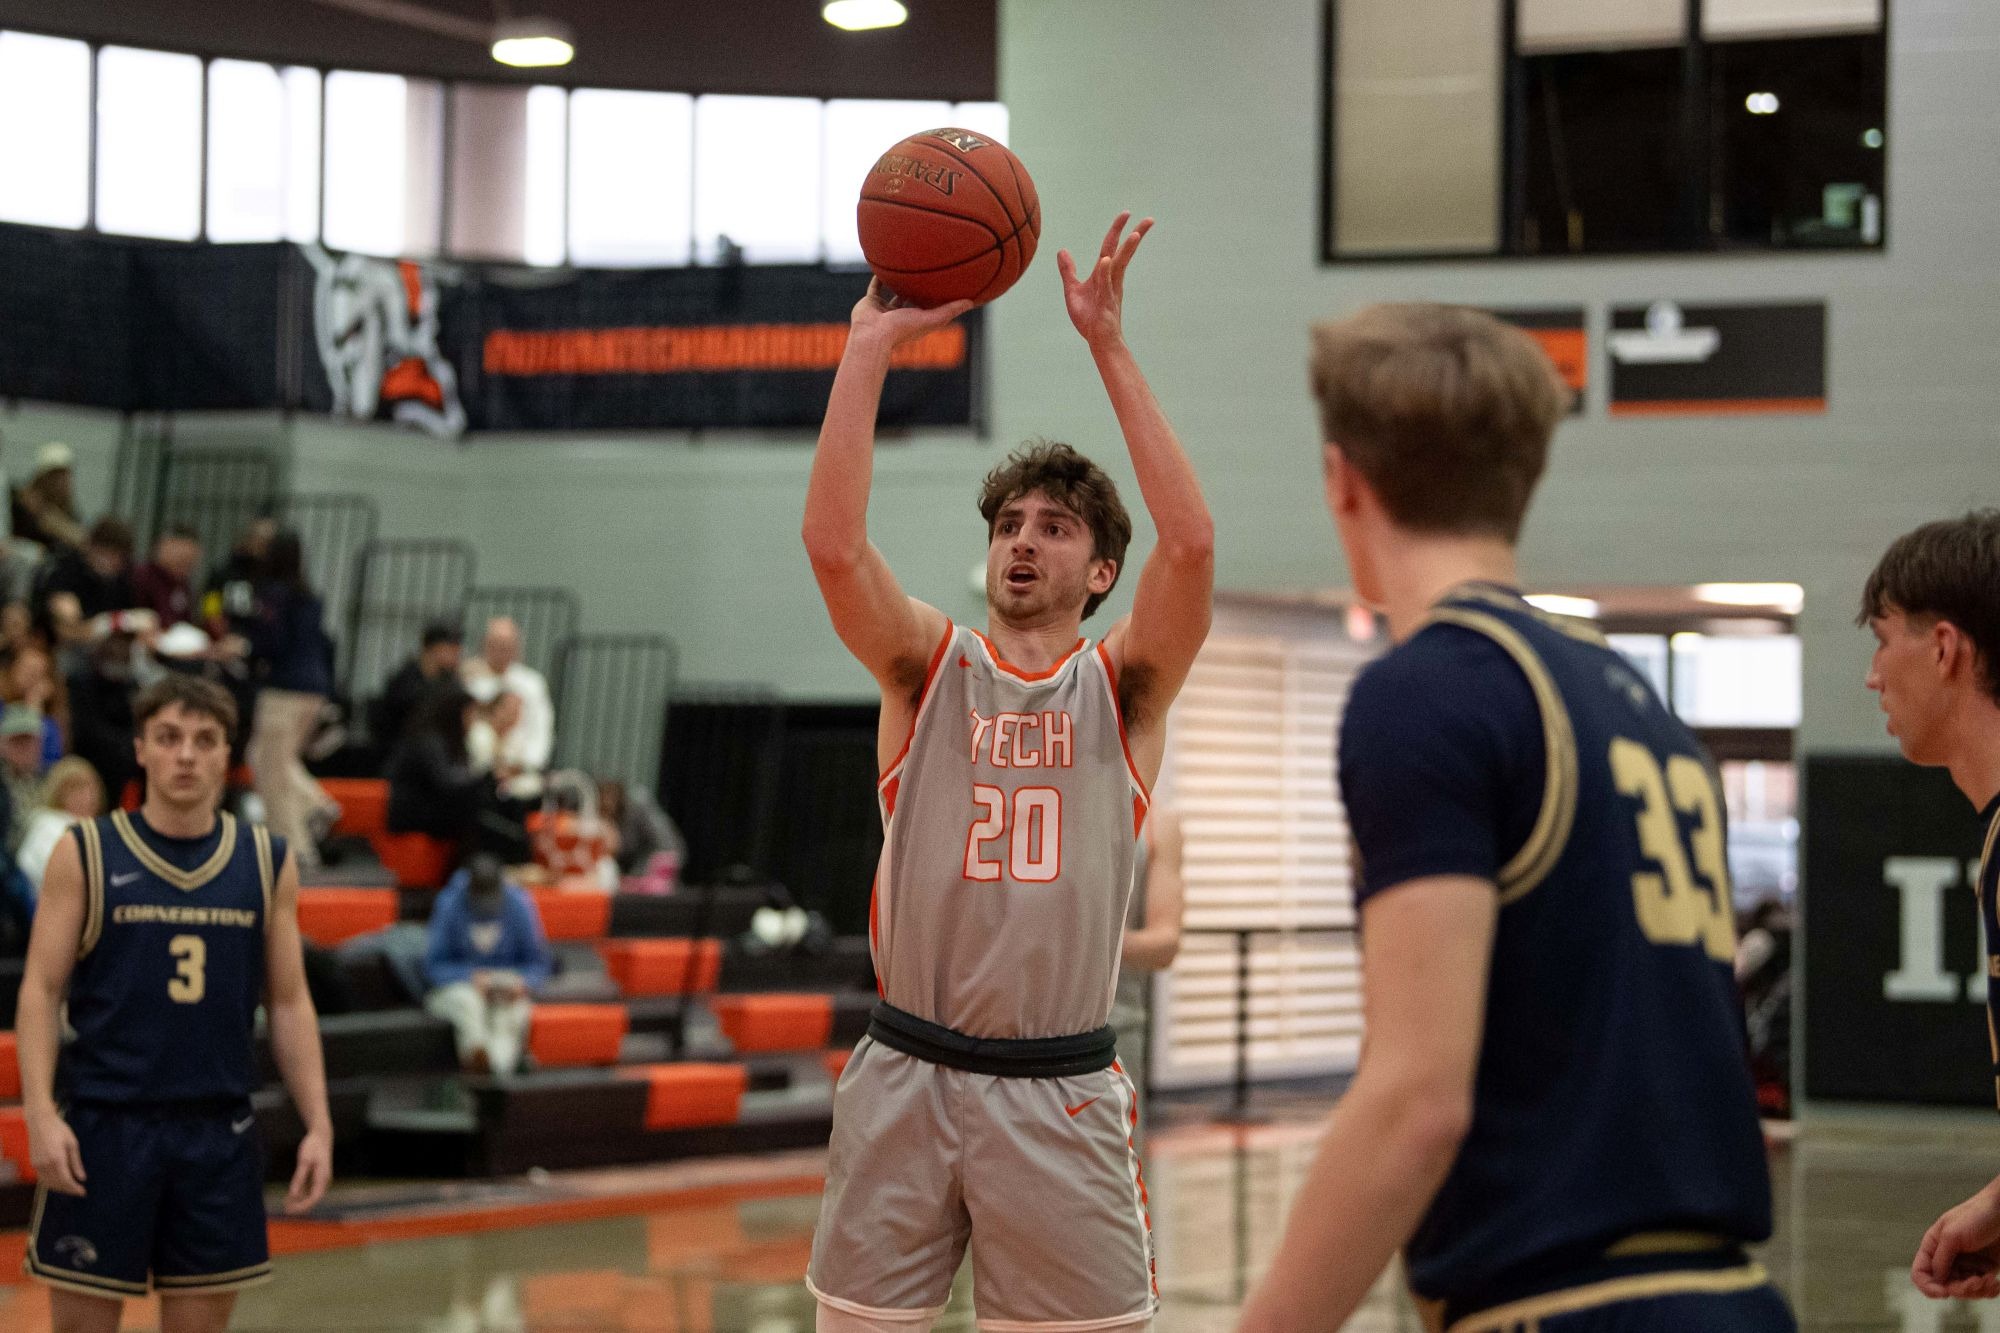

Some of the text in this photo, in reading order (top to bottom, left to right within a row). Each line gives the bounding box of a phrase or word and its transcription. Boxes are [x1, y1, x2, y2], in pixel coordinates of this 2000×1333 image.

[970, 708, 1073, 768] TECH
[963, 782, 1063, 884] 20
[1608, 736, 1736, 963] 33
[112, 905, 256, 928] CORNERSTONE
[167, 934, 207, 1004] 3
